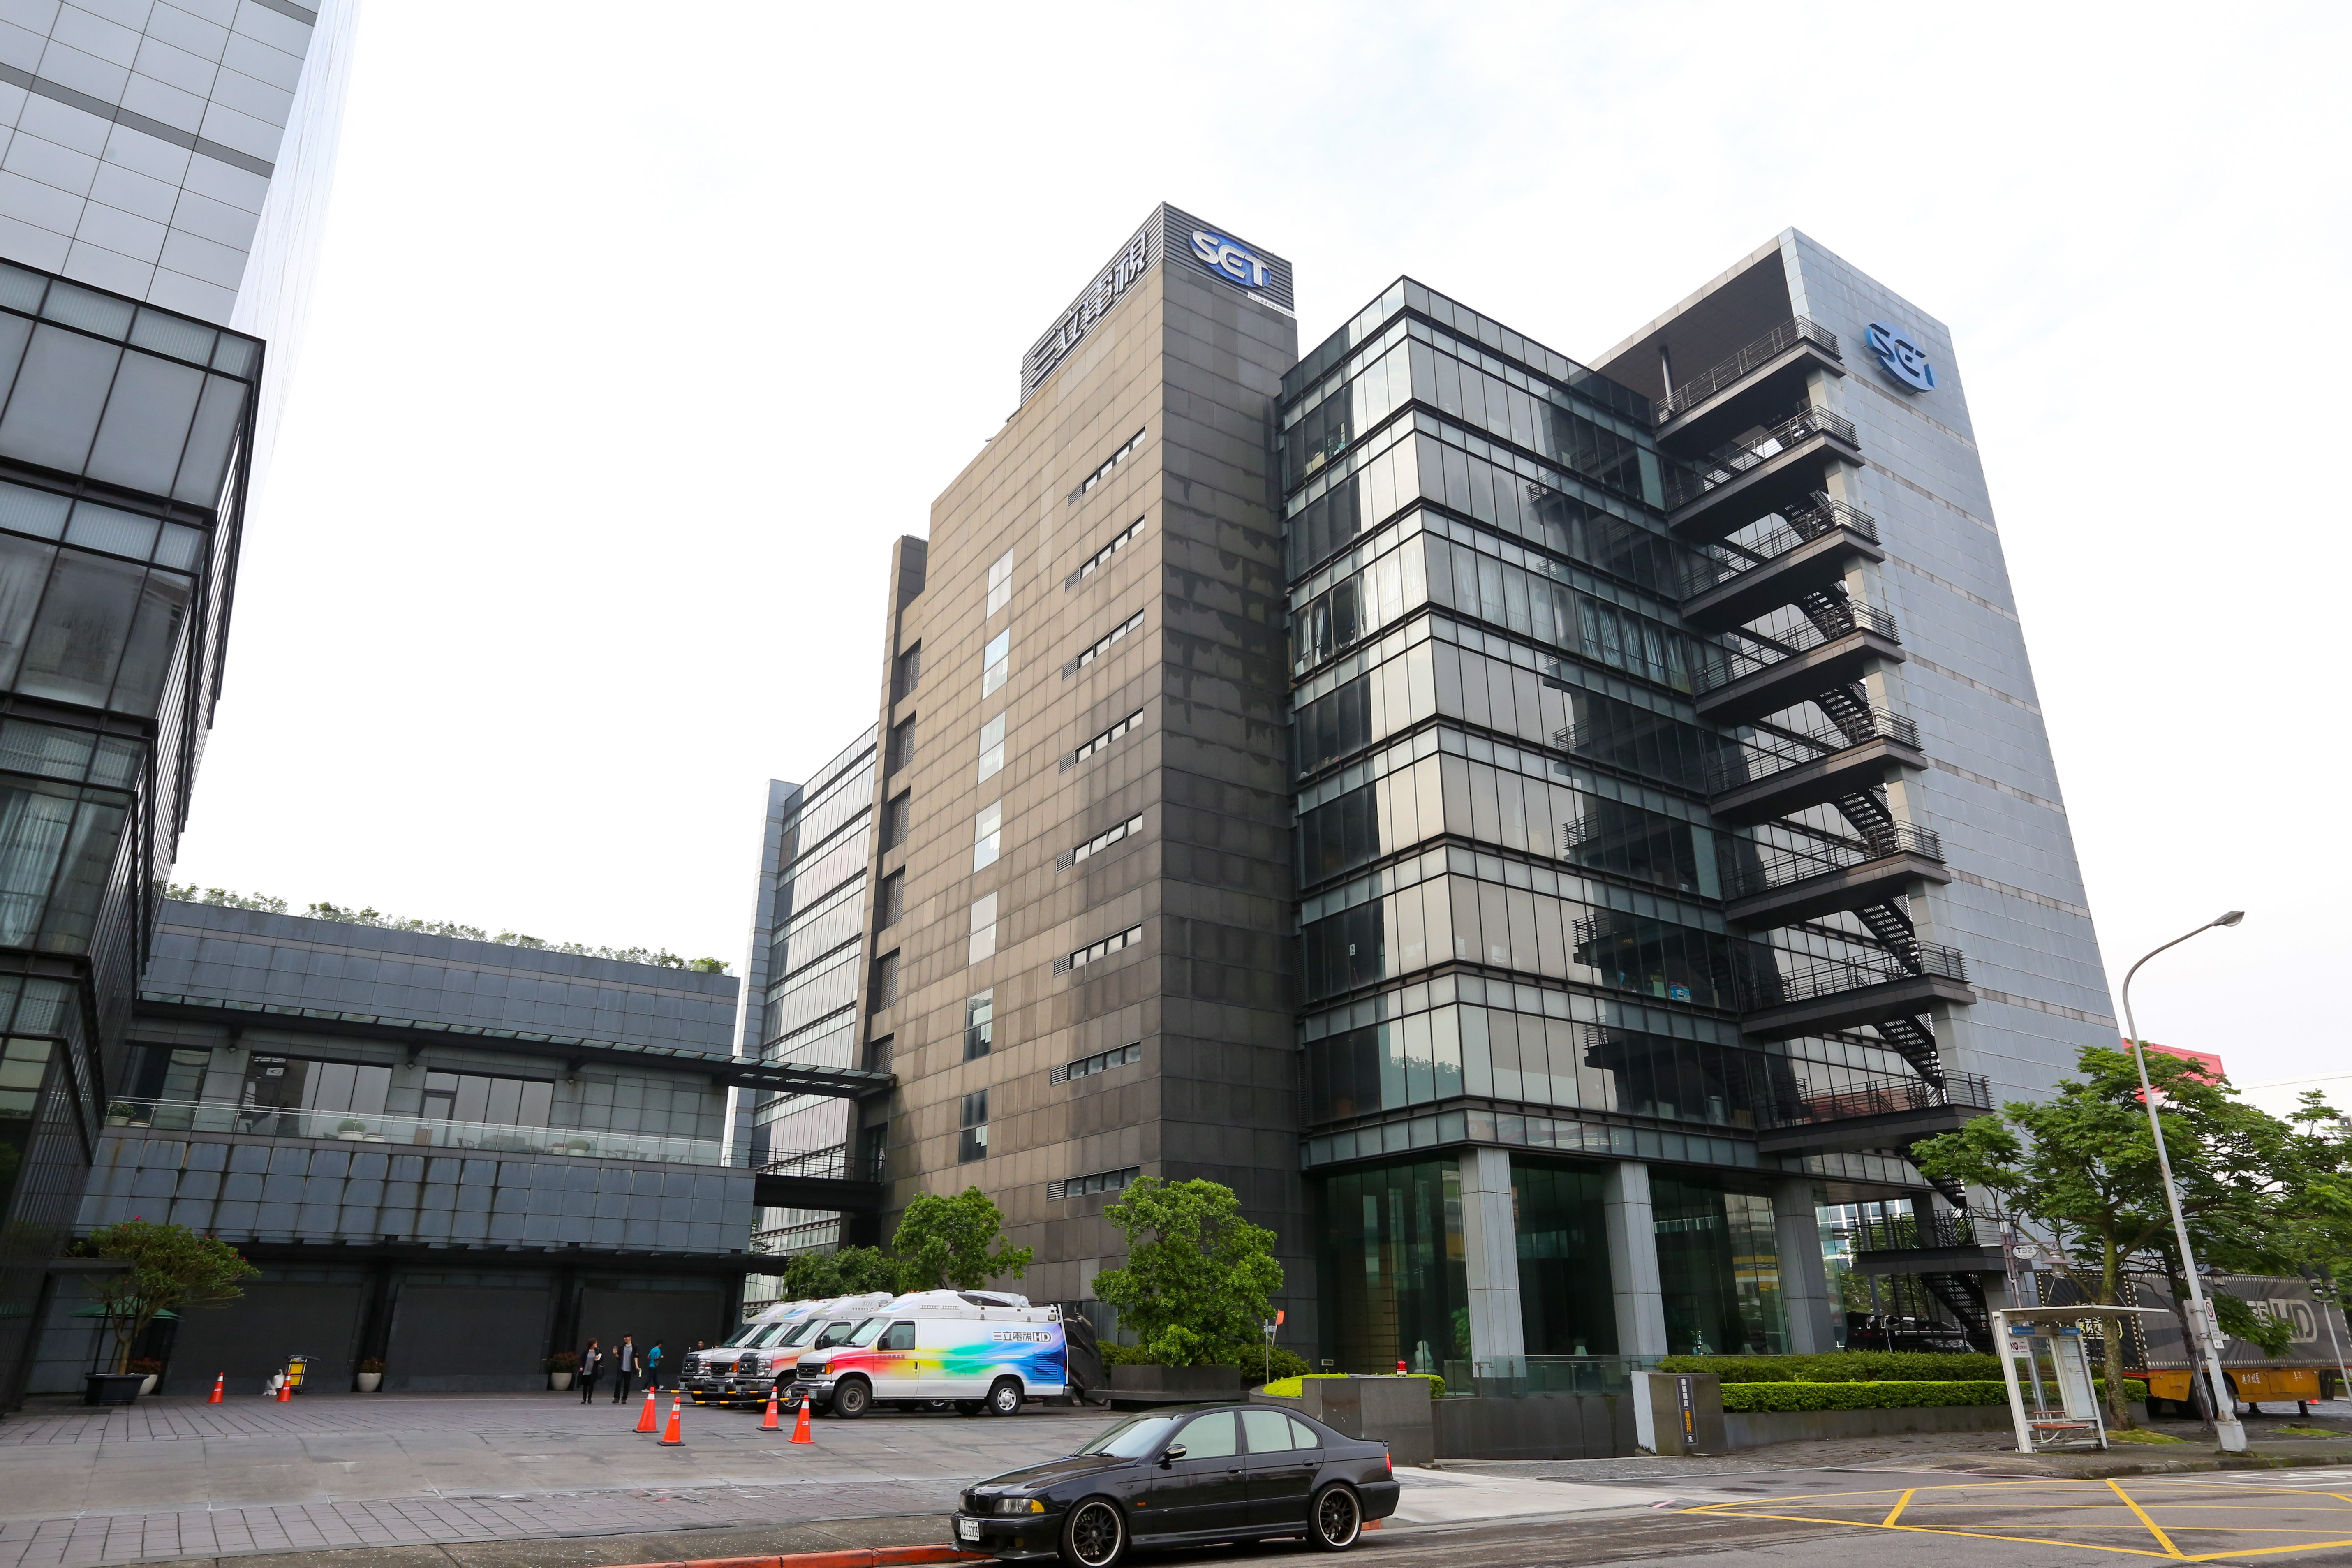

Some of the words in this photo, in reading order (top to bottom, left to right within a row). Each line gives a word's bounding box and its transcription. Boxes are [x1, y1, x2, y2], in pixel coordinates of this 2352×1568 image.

[1192, 230, 1267, 287] SET
[1031, 231, 1147, 387] 三立電視
[1868, 323, 1935, 388] SET
[993, 1331, 1051, 1342] 三立電視HD
